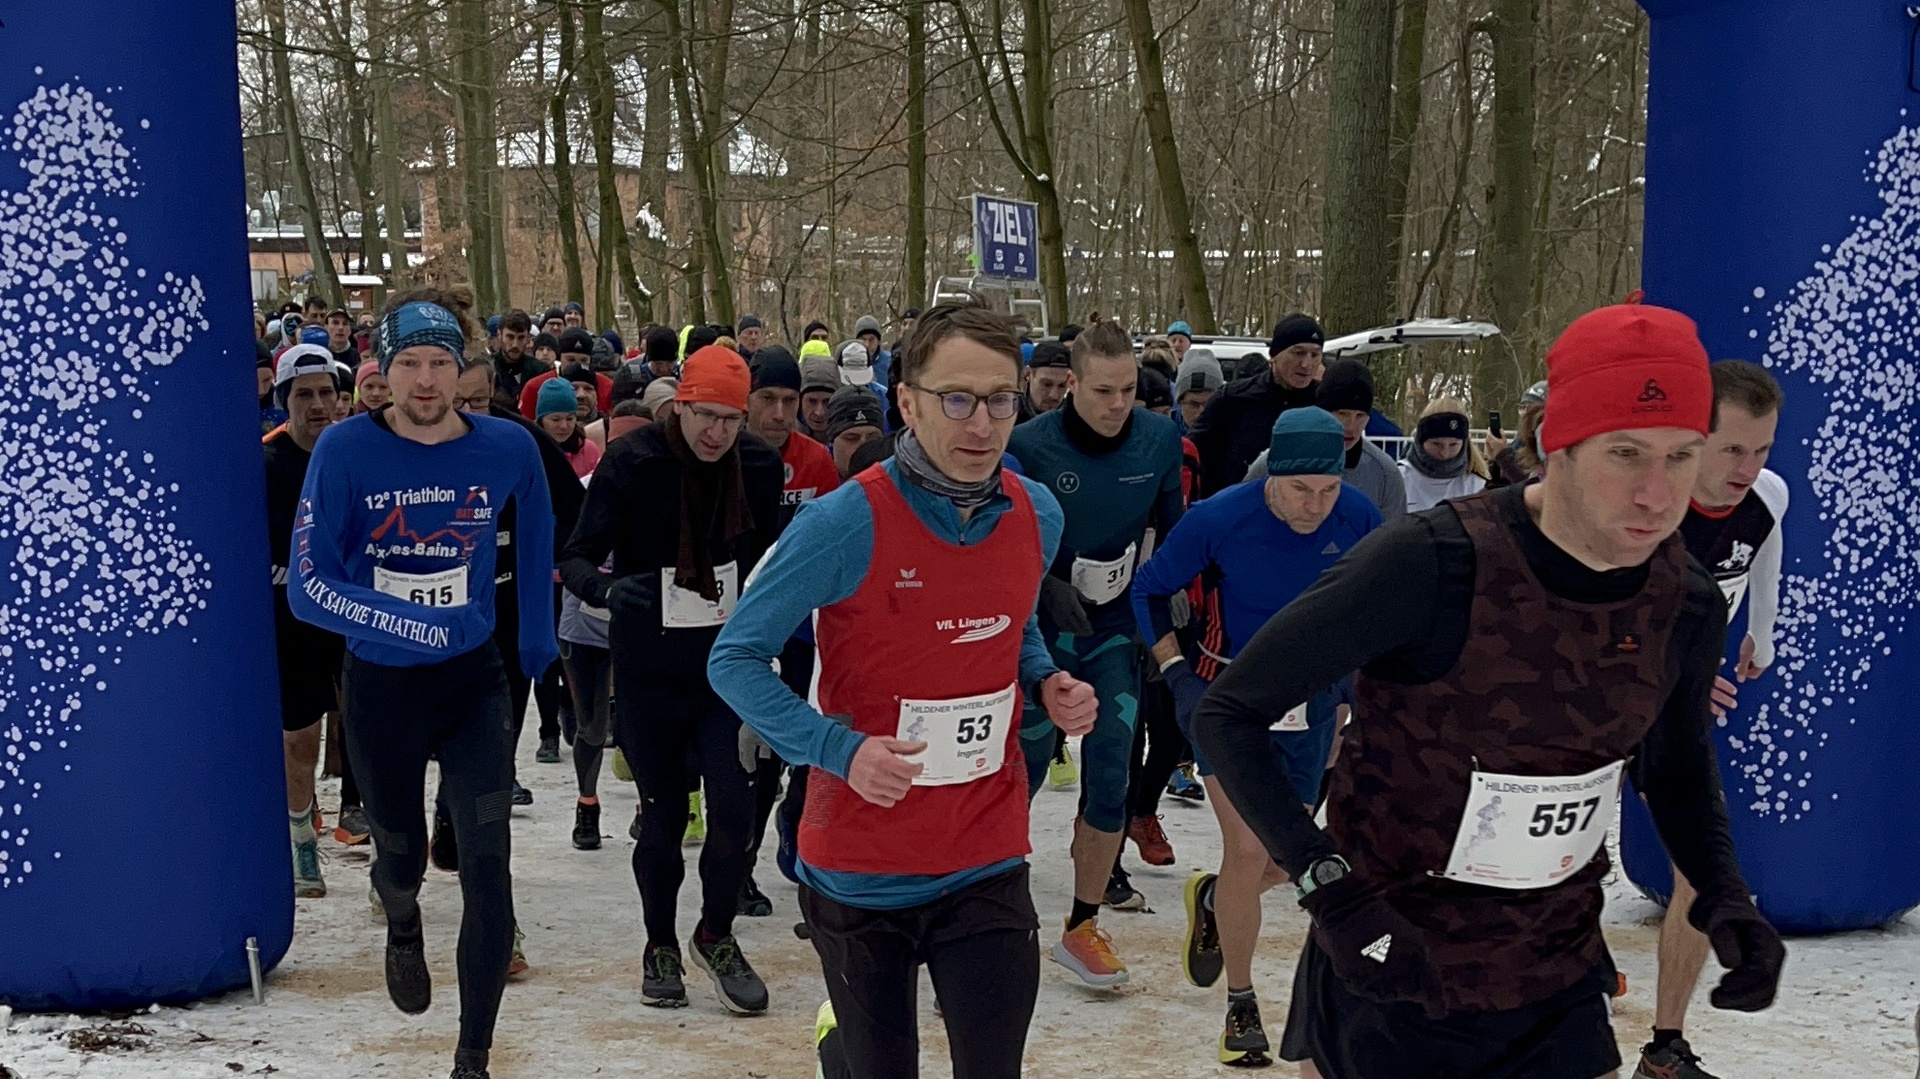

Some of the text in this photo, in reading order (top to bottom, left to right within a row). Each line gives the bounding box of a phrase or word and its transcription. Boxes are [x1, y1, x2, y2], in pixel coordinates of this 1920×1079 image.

[987, 201, 1027, 246] ZIEL
[392, 486, 456, 506] Triathlon
[1107, 563, 1126, 584] 31
[409, 585, 453, 607] 615
[302, 576, 450, 648] AIX SAVOIE TRIATHLON
[958, 616, 996, 629] Lingen
[911, 705, 951, 714] HILDENER
[956, 714, 993, 745] 53
[1485, 781, 1539, 794] HILDENER
[1528, 795, 1602, 838] 557
